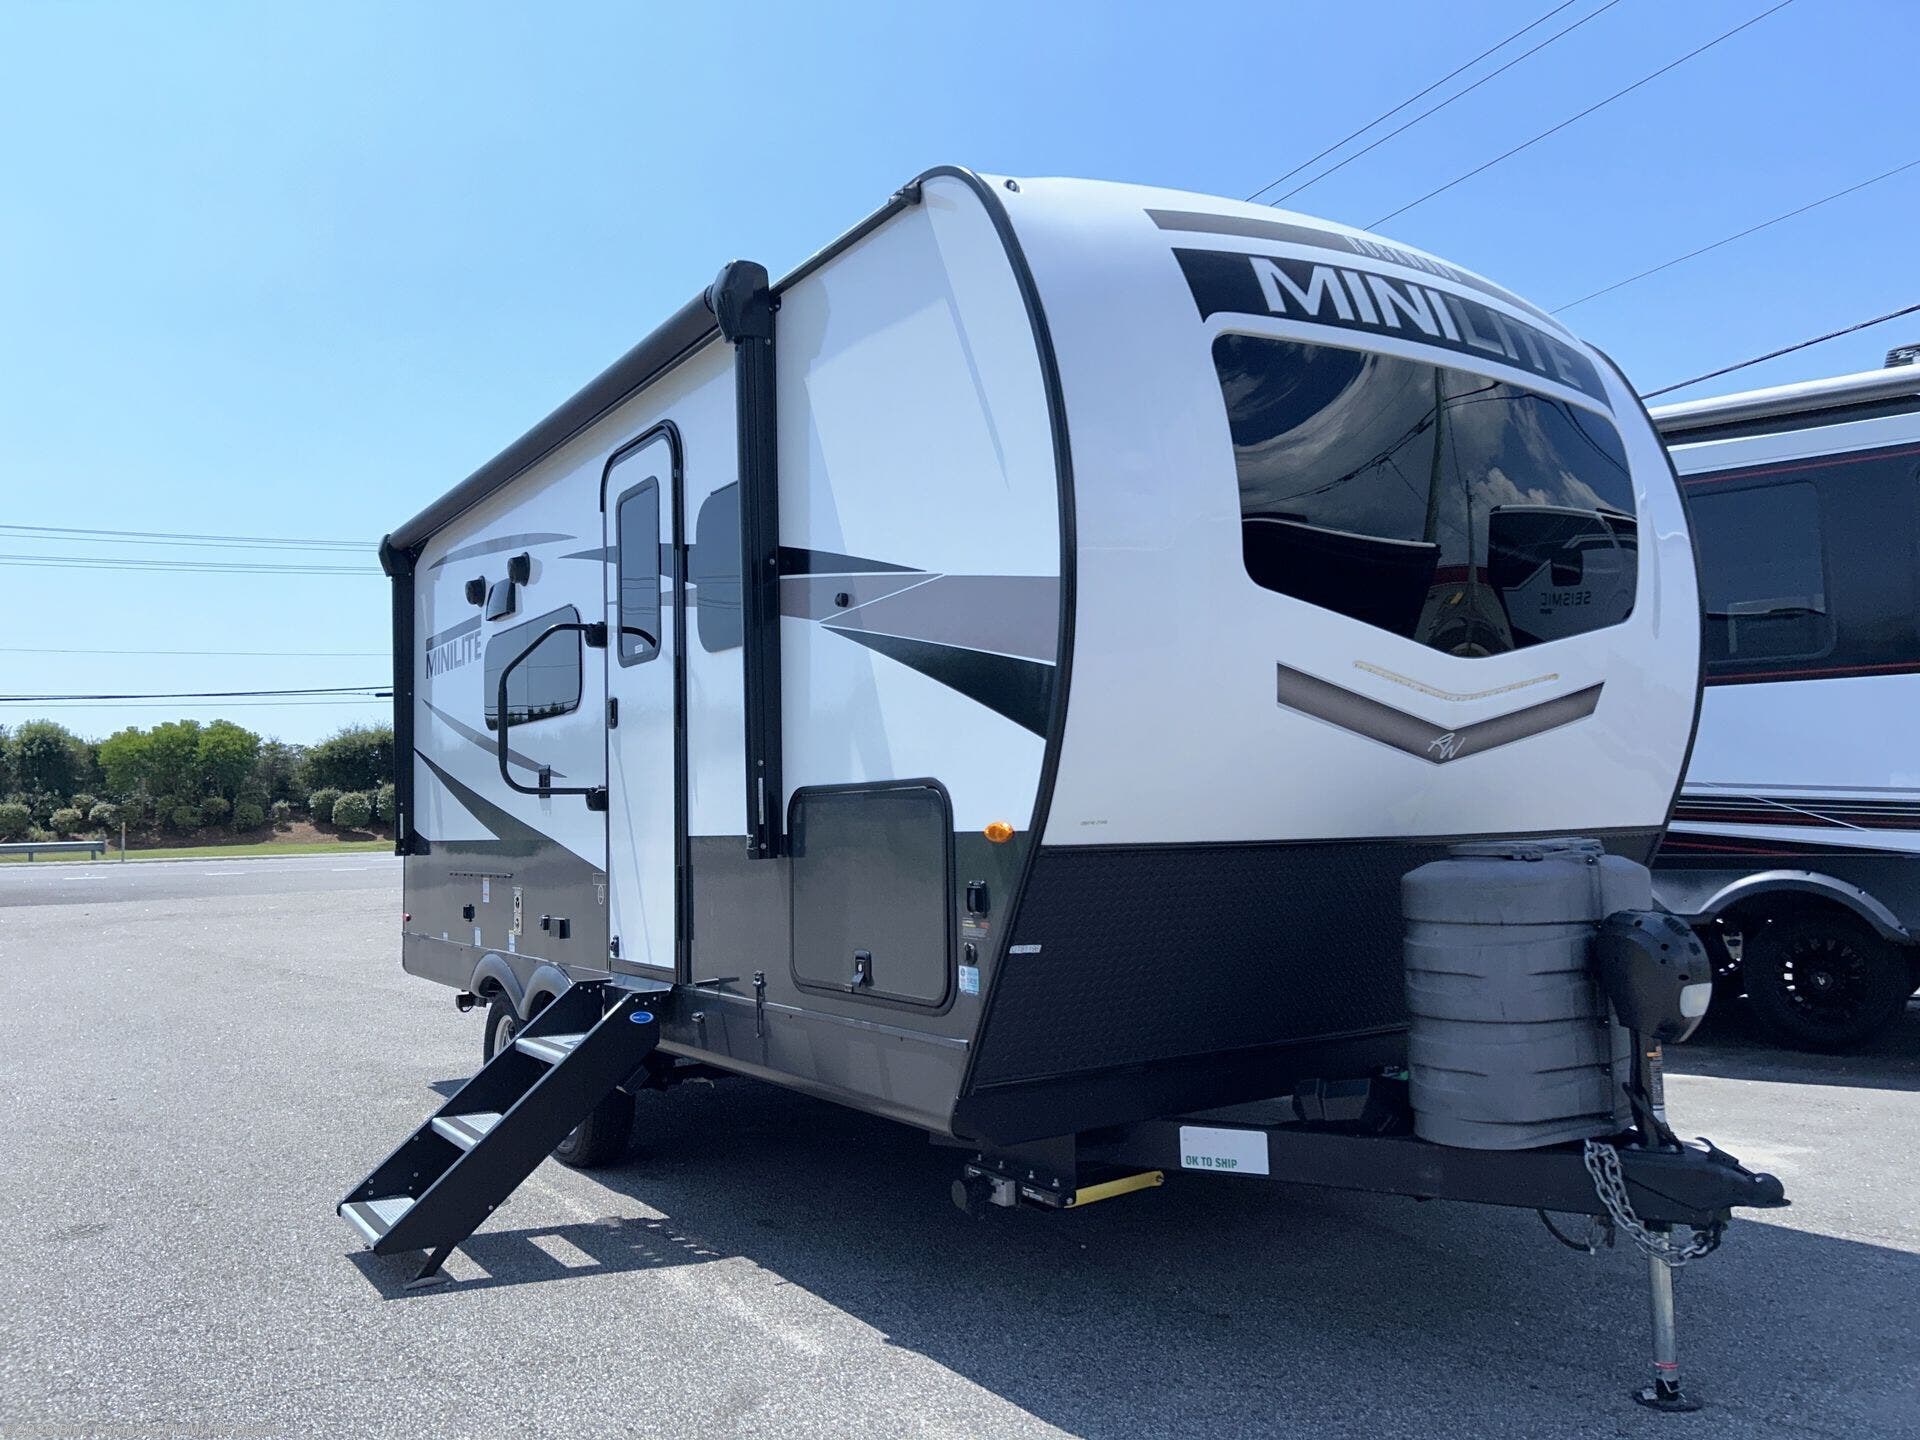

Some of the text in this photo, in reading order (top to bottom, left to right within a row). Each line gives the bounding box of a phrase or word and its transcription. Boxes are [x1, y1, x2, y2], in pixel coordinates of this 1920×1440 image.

[1249, 256, 1583, 390] MINILITE
[426, 629, 482, 680] MINILITE
[1185, 1155, 1238, 1169] OK TO SHIP
